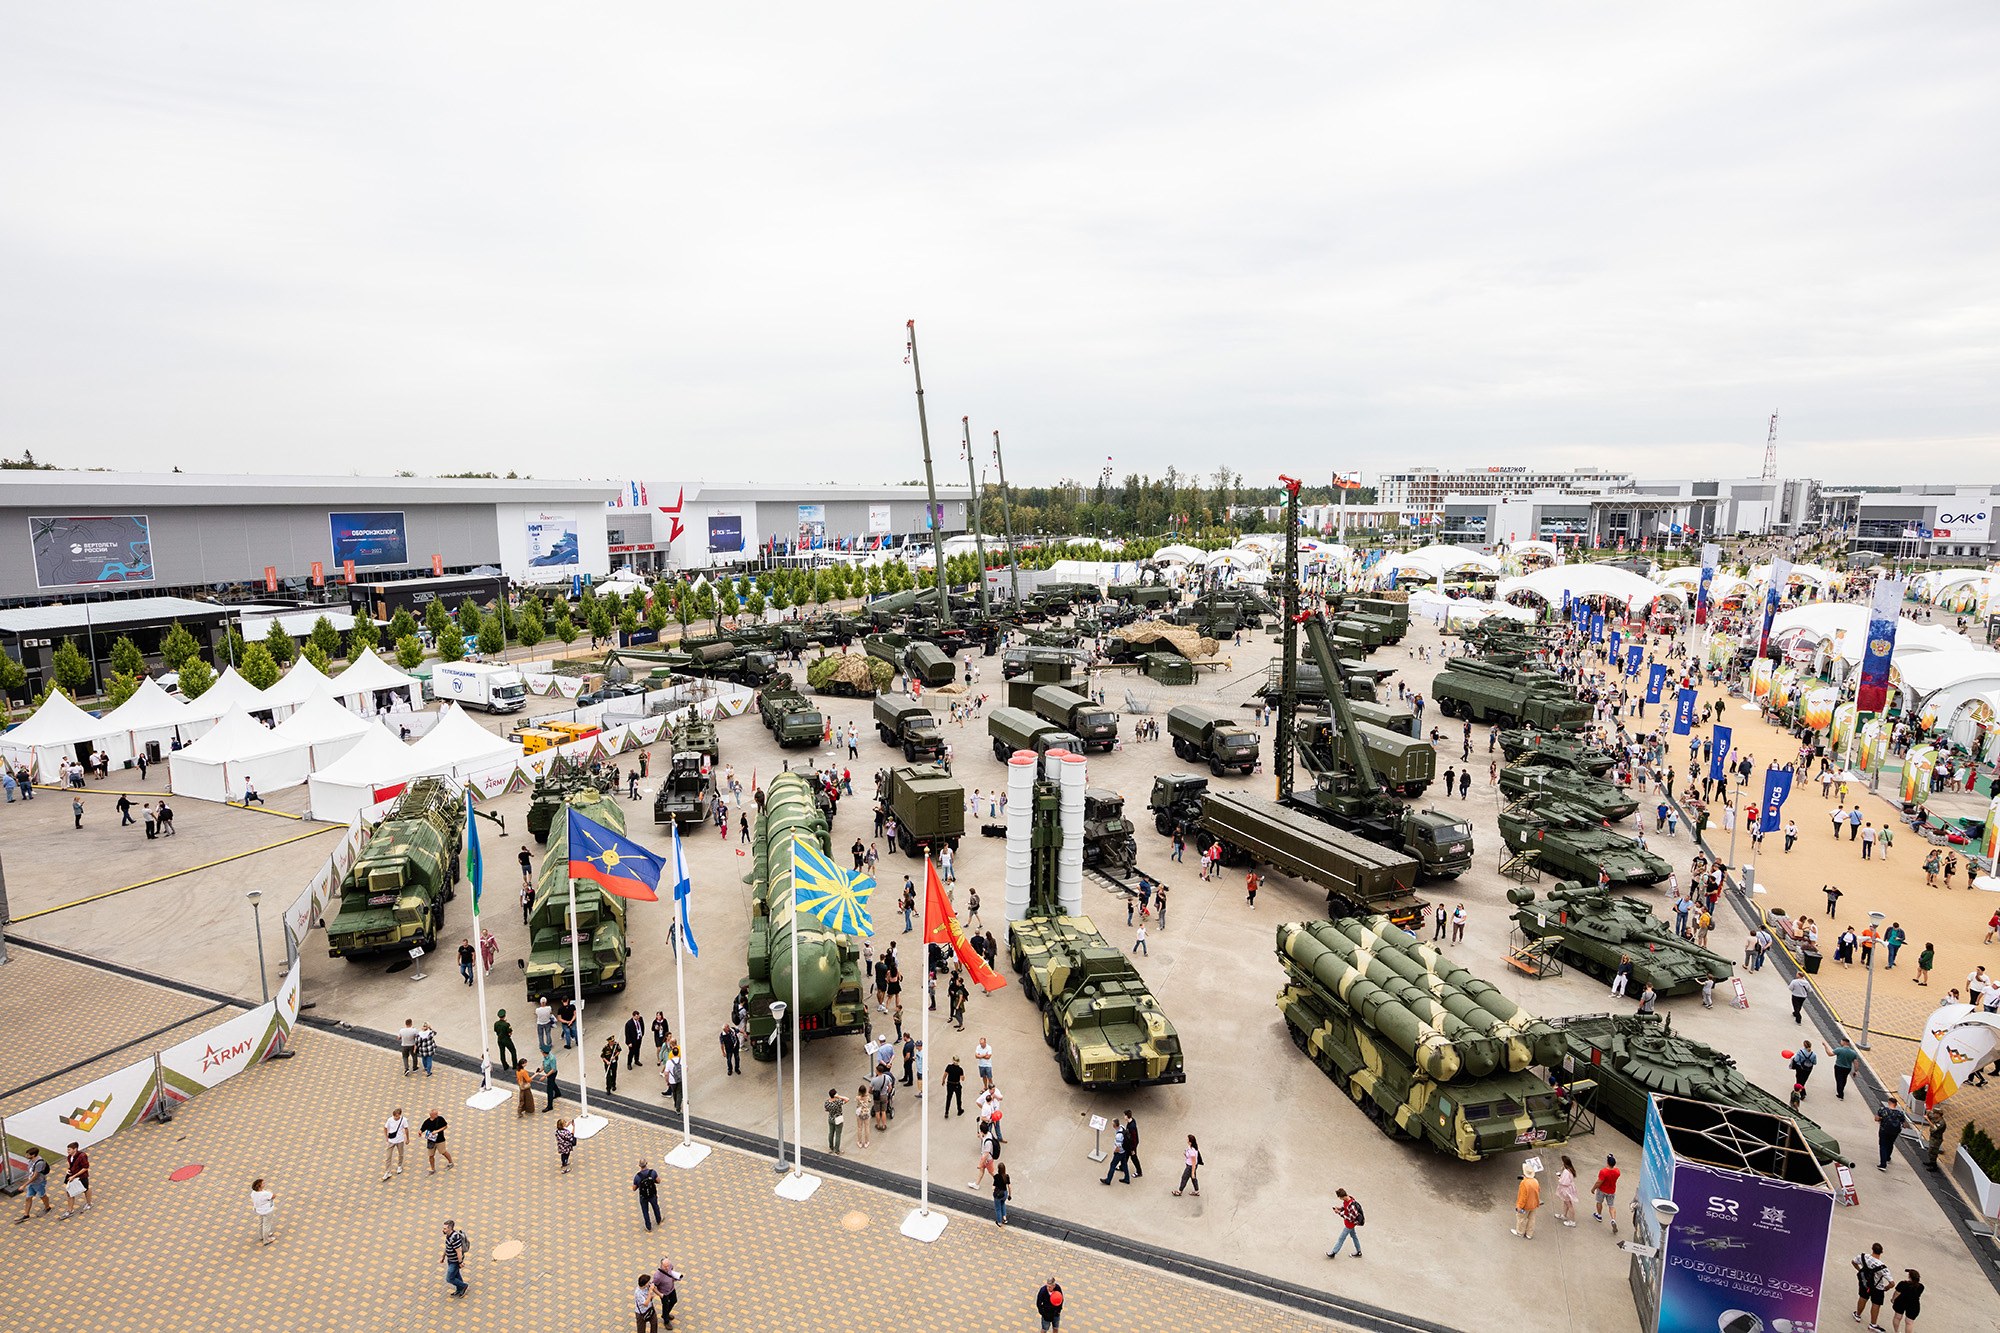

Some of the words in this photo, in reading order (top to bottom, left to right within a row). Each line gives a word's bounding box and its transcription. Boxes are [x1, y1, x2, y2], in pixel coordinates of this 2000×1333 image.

[1940, 513, 1976, 524] ОАК
[608, 545, 635, 553] ПАТРИОТ
[637, 543, 656, 551] ЭКСПО
[1682, 701, 1690, 715] ПСБ
[485, 776, 506, 790] ARMY
[1774, 786, 1783, 806] ПСБ
[201, 1037, 253, 1074] ARMY
[1707, 1196, 1740, 1217] SR
[1705, 1210, 1738, 1223] space
[1670, 1255, 1763, 1285] РОБОТЕКА
[1767, 1277, 1815, 1298] 2022
[1697, 1273, 1729, 1288] 15-21
[1731, 1281, 1783, 1300] АВГУСТА
